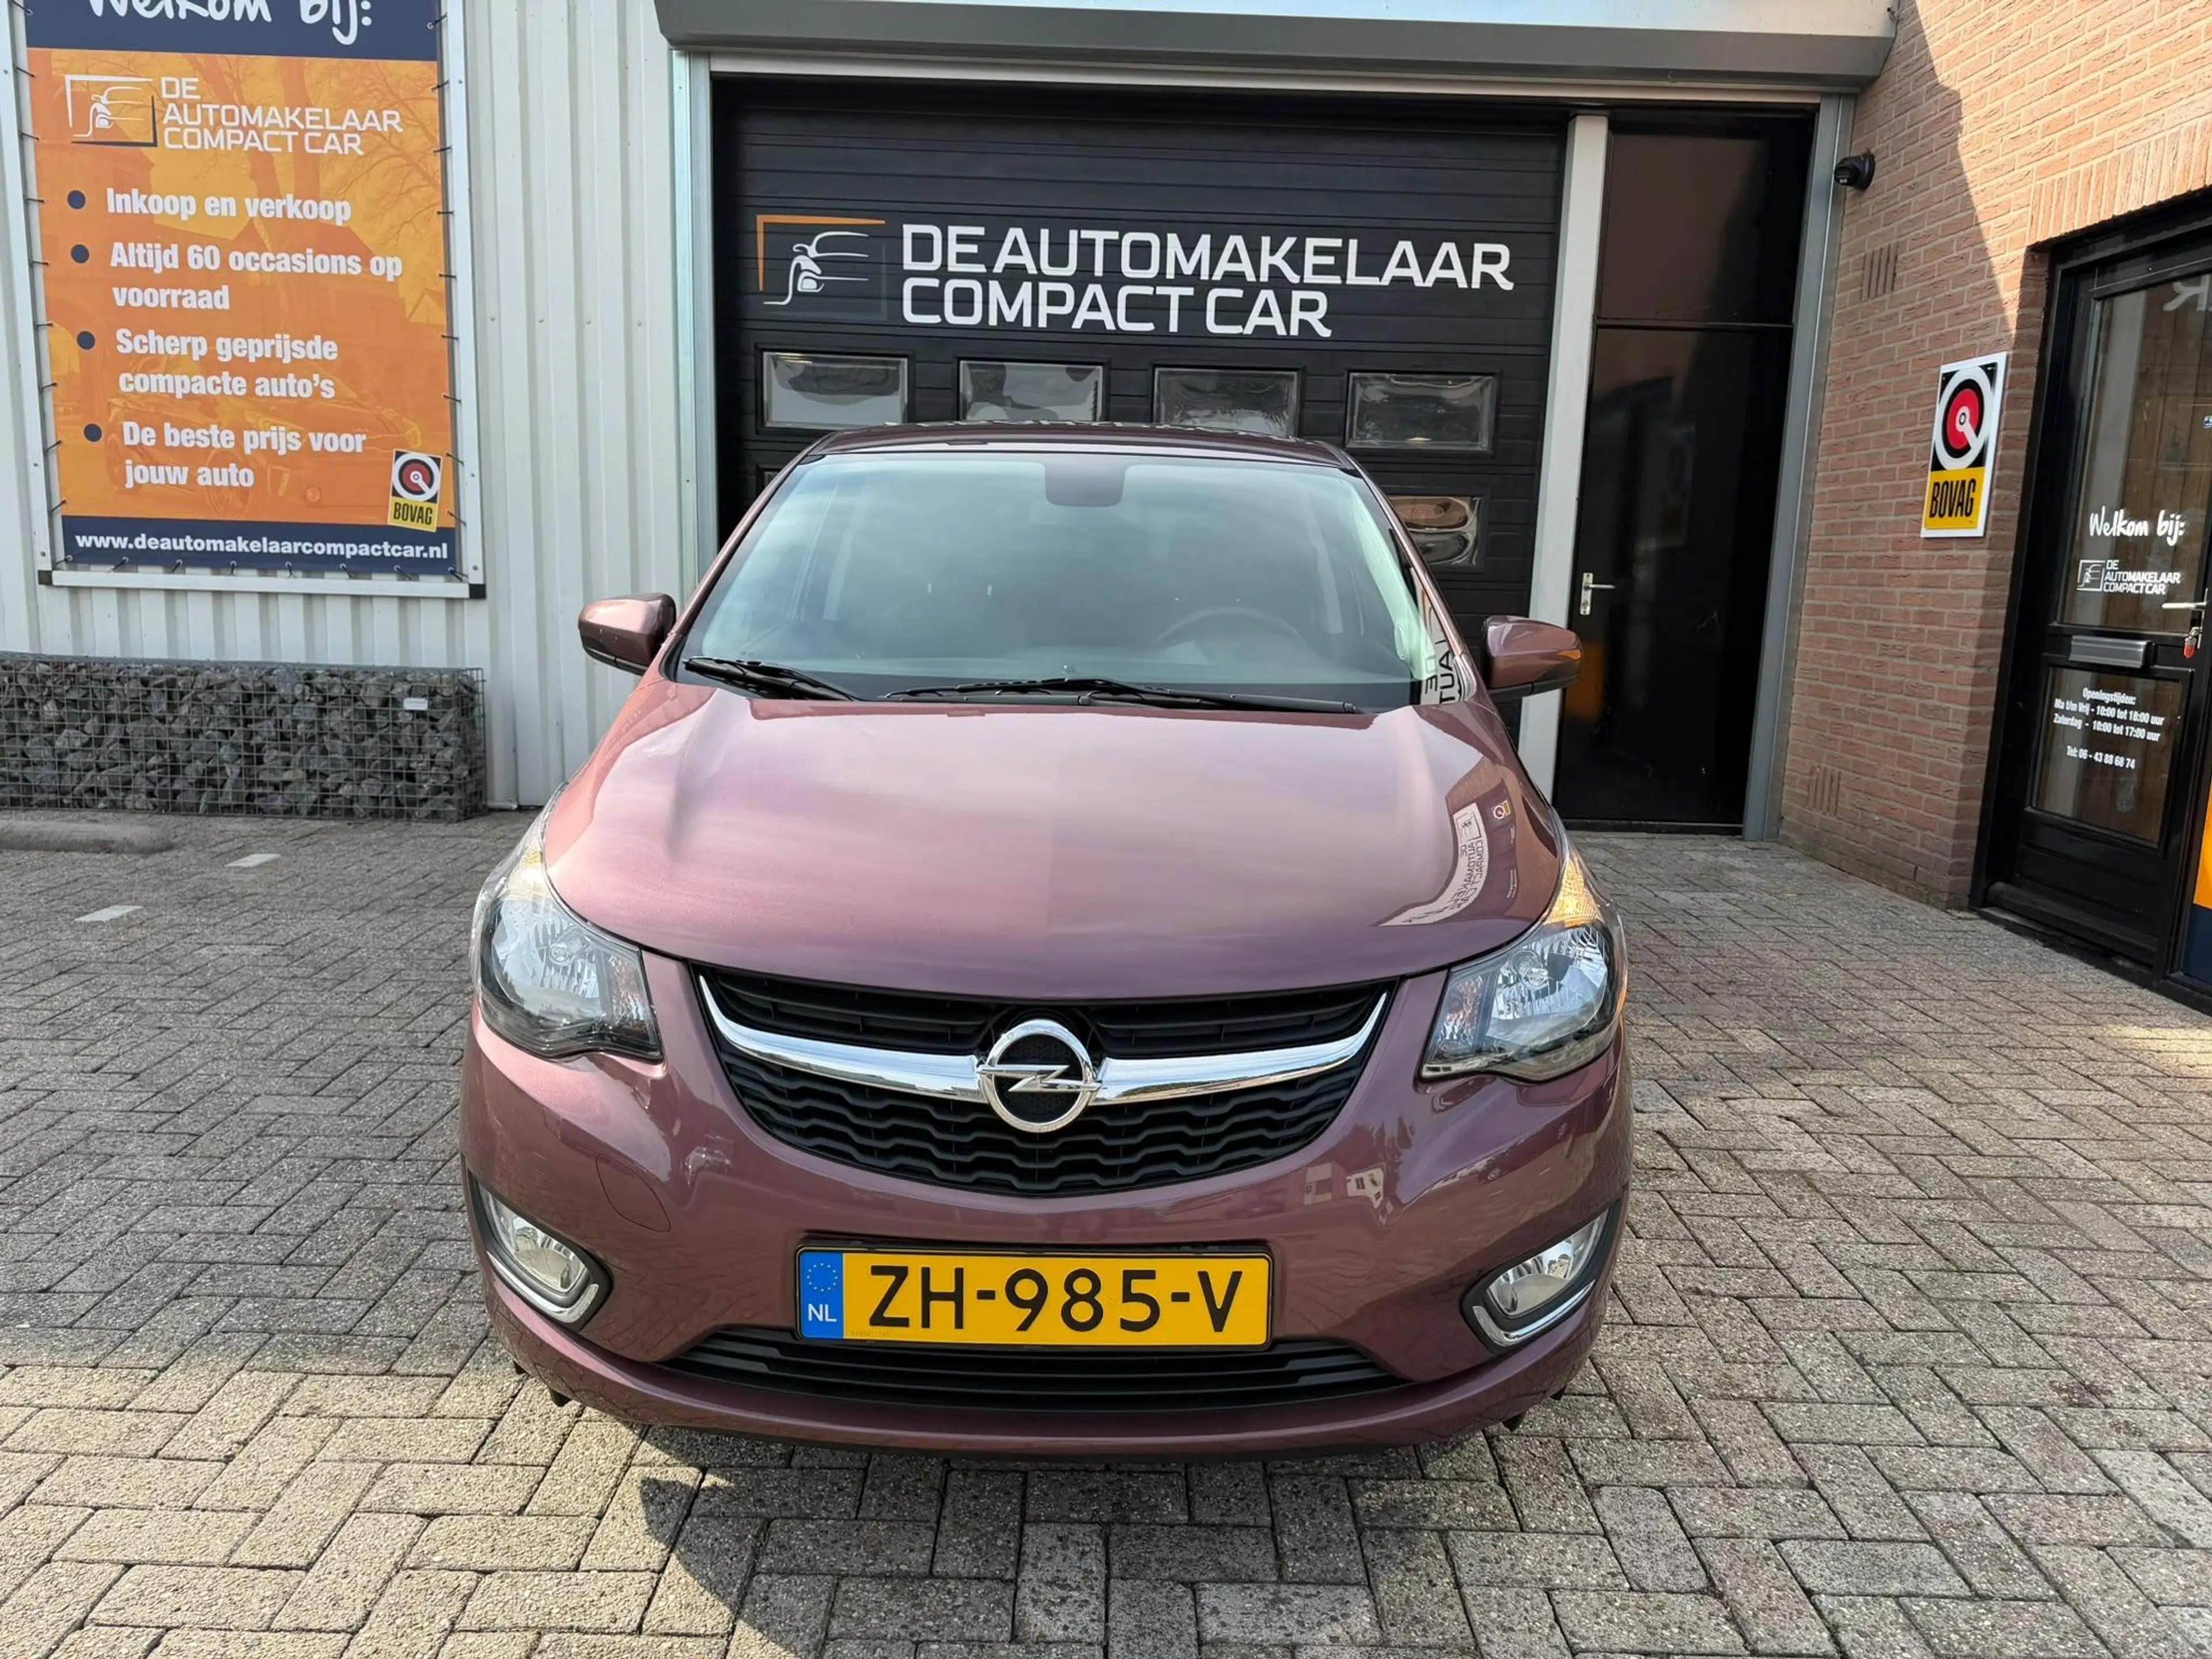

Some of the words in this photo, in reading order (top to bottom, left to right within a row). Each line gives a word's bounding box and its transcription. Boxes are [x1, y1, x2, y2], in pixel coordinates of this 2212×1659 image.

[161, 77, 200, 100] DE
[162, 104, 404, 132] AUTOMAKELAAR
[164, 127, 298, 153] COMPACT
[304, 131, 364, 156] CAR
[107, 188, 196, 220] Inkoop
[206, 195, 236, 217] en
[245, 196, 351, 225] verkoop
[110, 242, 179, 273] Altijd
[187, 245, 221, 270] 60
[229, 248, 361, 275] occasions
[370, 256, 403, 282] op
[903, 224, 986, 273] DE
[992, 226, 1515, 291] AUTOMAKELAAR
[112, 286, 230, 310] voorraad
[903, 278, 1195, 332] COMPACT
[1204, 288, 1332, 338] CAR
[116, 329, 208, 361] Scherp
[216, 333, 338, 363] geprijsde
[119, 373, 247, 399] compacte
[255, 374, 335, 399] auto's
[123, 422, 156, 447] De
[164, 422, 236, 449] beste
[244, 427, 302, 456] prijs
[310, 431, 366, 453] voor
[124, 461, 188, 488] jouw
[198, 464, 255, 487] auto
[1929, 478, 1976, 518] BOVAG
[393, 502, 433, 525] BOVAG
[2089, 505, 2148, 536] Welkom
[2157, 509, 2186, 546] bij:
[75, 533, 448, 559] www.deautomakelaarcompactcar.nl
[2104, 571, 2181, 584] AUTOMAKELAAR
[2106, 559, 2119, 570] DE
[2103, 582, 2146, 594] COMPACT
[2145, 584, 2165, 594] CAR
[2096, 706, 2116, 718] 10:00
[2116, 709, 2127, 720] tot
[2129, 710, 2149, 724] 18:00
[2150, 715, 2165, 726] uur
[2093, 720, 2112, 733] 10:00
[2113, 723, 2123, 736] tot
[2125, 726, 2145, 740] 17:00
[2146, 730, 2161, 742] uur
[2093, 752, 2103, 763] 43
[2126, 758, 2135, 770] 74
[869, 1265, 1243, 1332] ZH-985-V
[808, 1304, 837, 1323] NL
